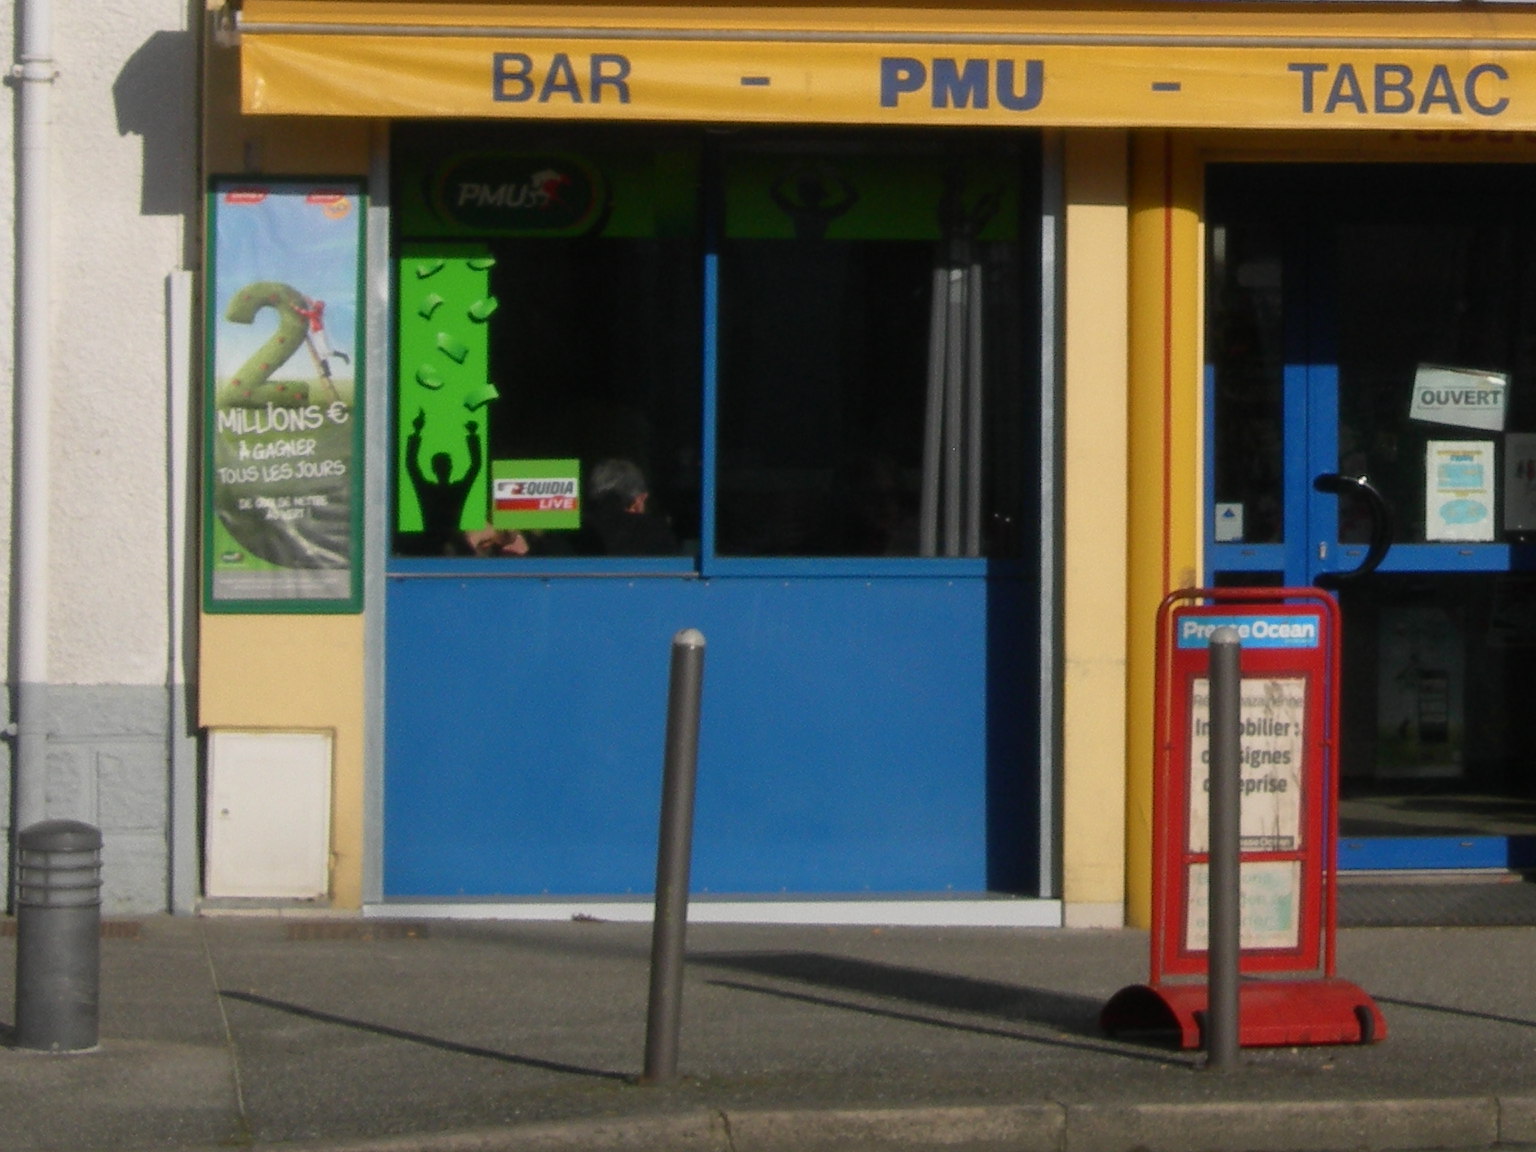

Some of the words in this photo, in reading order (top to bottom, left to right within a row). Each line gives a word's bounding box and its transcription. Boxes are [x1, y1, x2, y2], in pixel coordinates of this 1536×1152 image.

[491, 52, 632, 103] BAR
[741, 77, 769, 87] -
[878, 56, 1045, 112] PMU
[1152, 82, 1180, 92] -
[1287, 62, 1510, 116] TABAC
[457, 183, 528, 207] PMU
[1420, 389, 1500, 406] OUVERT
[327, 401, 349, 424] €
[252, 439, 316, 460] GAGNER
[218, 466, 259, 484] TOUS
[261, 463, 293, 482] LES
[294, 460, 346, 478] JOURS
[510, 481, 574, 496] EQUIDIA
[538, 497, 574, 510] LIVE
[1183, 621, 1250, 639] Pree
